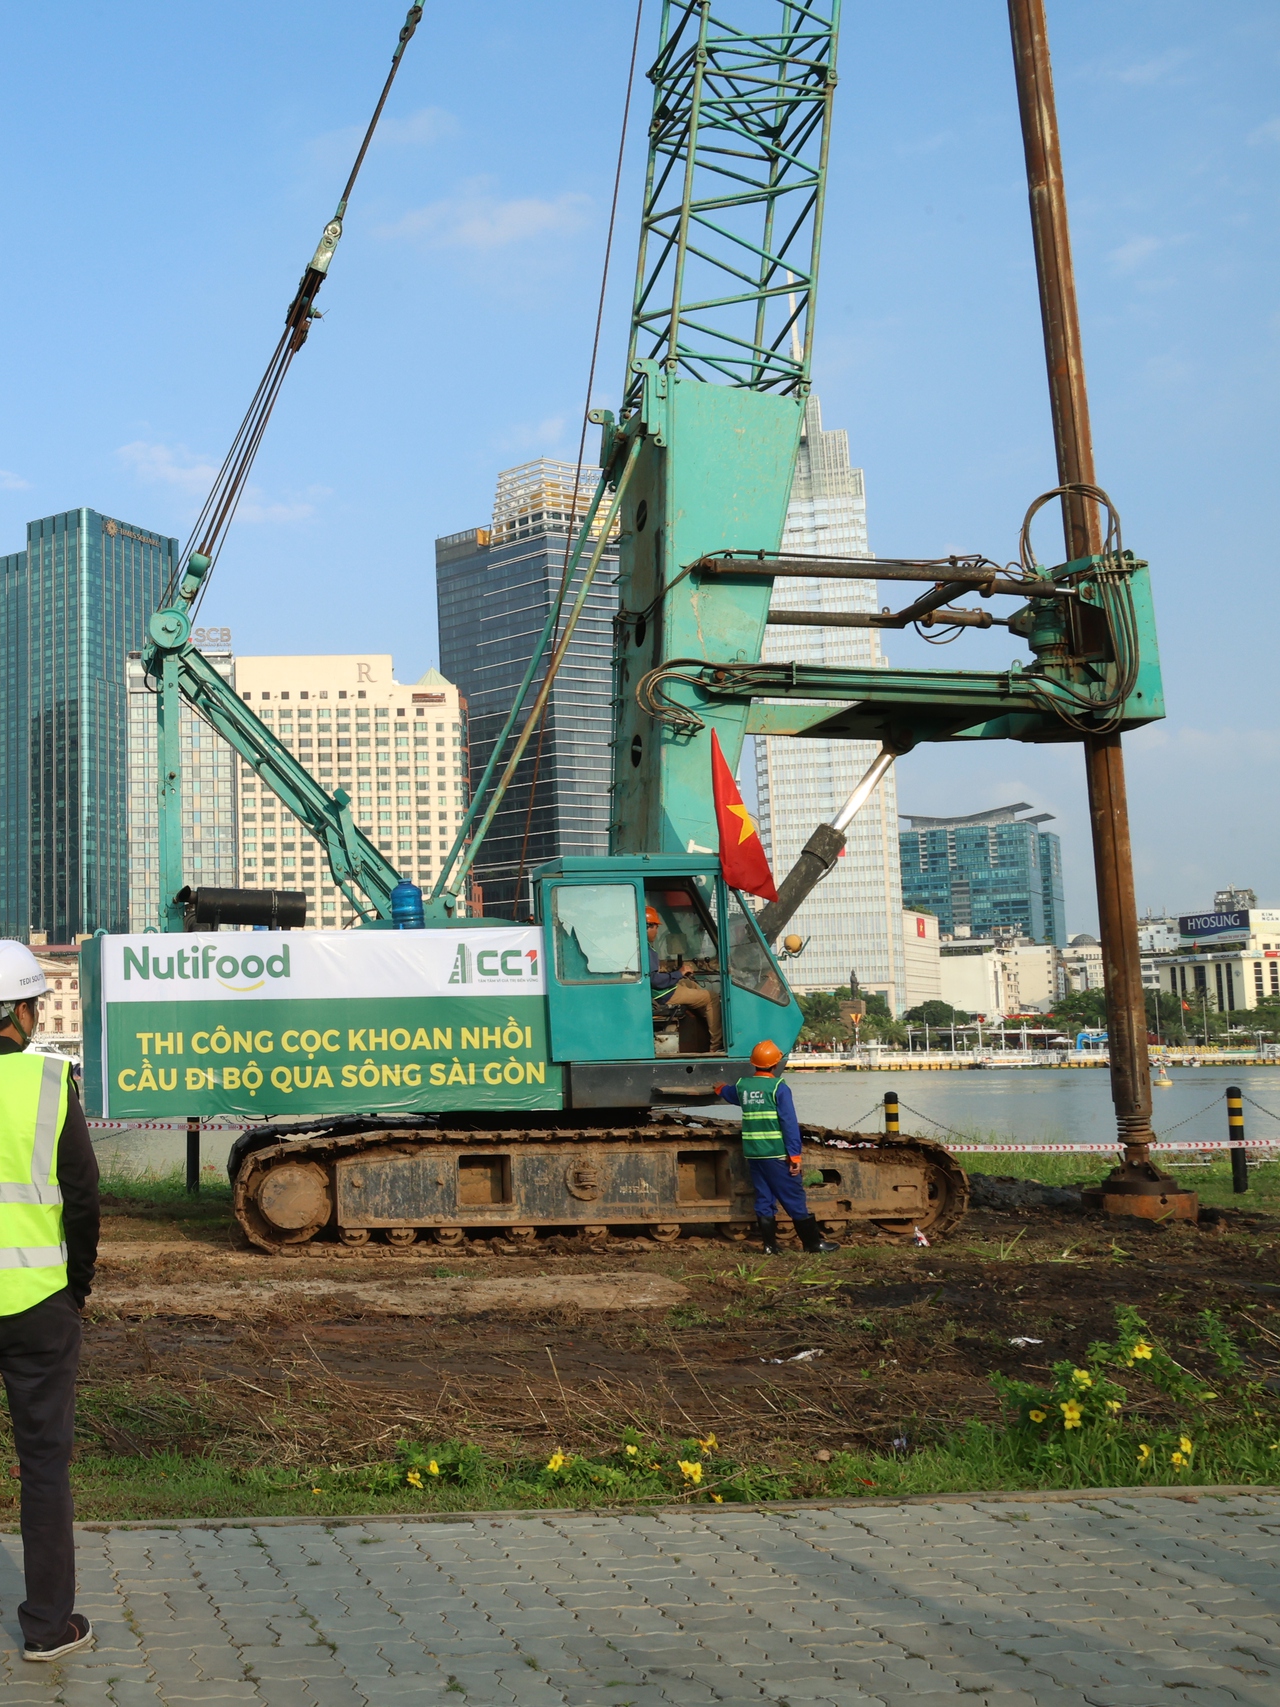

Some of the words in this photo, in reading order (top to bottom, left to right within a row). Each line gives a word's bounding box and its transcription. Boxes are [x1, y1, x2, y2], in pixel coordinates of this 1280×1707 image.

[136, 533, 161, 548] SQUARE
[194, 627, 232, 643] SCB
[356, 662, 378, 683] R
[1187, 914, 1240, 930] HYOSUNG
[123, 943, 291, 981] Nutifood
[476, 949, 538, 976] CC1
[19, 976, 32, 986] TEDI
[135, 1031, 183, 1055] THI
[191, 1025, 274, 1054] CÔNG
[281, 1029, 341, 1060] CỌC
[348, 1027, 452, 1051] KHOAN
[460, 1016, 532, 1049] NHỒI
[117, 1058, 177, 1092] CẦU
[185, 1067, 214, 1090] ĐI
[223, 1060, 264, 1097] BỘ
[270, 1065, 334, 1094] QUA
[340, 1058, 422, 1088] SÔNG
[429, 1056, 476, 1086] SÀI
[483, 1055, 545, 1085] GÒN
